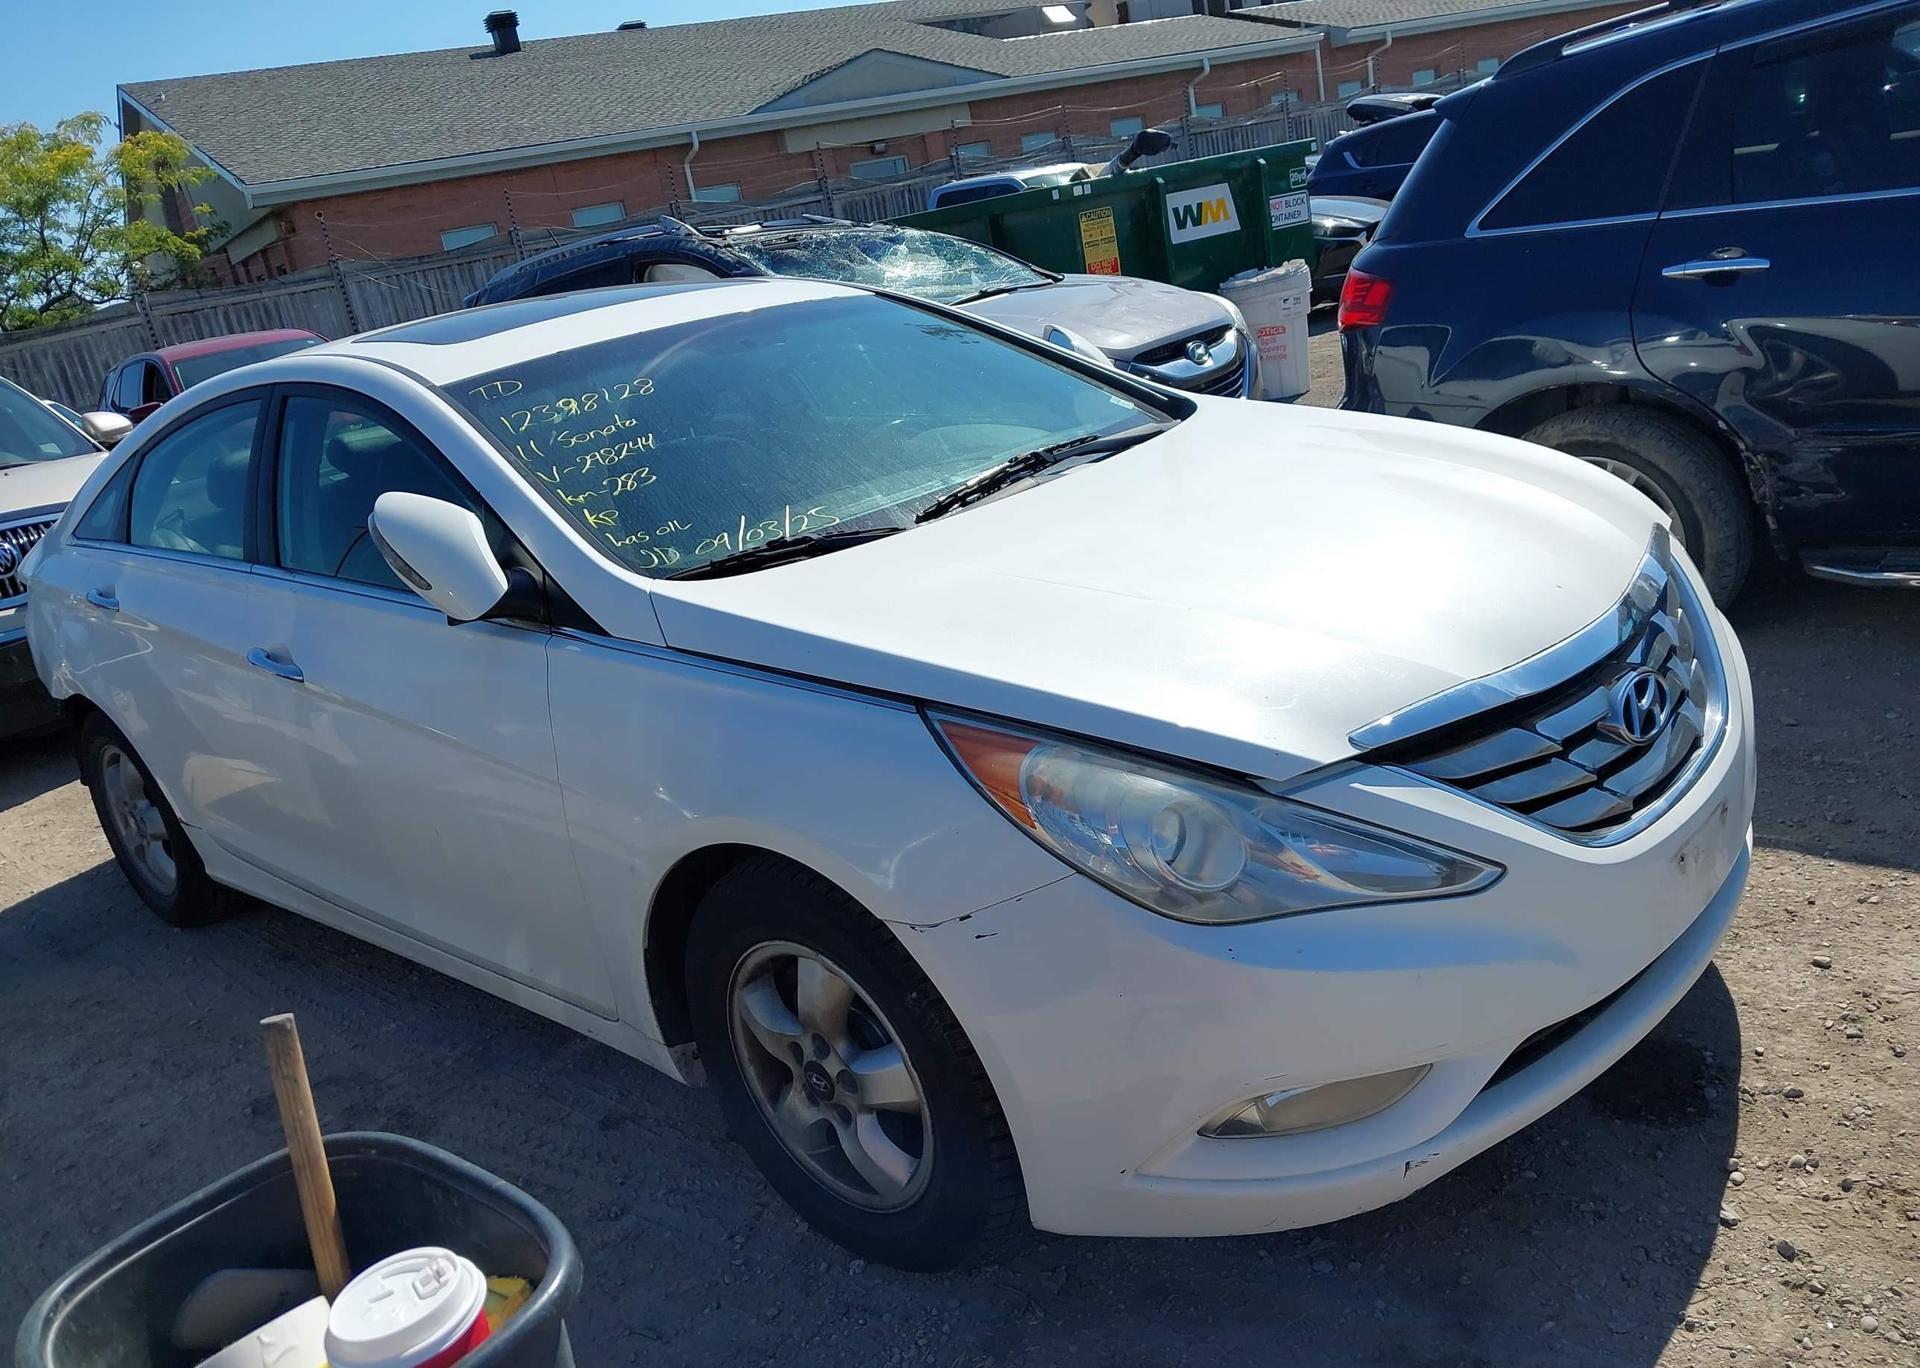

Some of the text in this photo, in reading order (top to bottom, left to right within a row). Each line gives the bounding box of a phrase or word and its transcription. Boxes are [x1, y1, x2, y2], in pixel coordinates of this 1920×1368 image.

[1284, 197, 1306, 209] BLOCK
[1086, 208, 1111, 221] CAUTION
[1172, 197, 1231, 231] WM
[1271, 210, 1302, 223] ONTAINER
[1260, 326, 1286, 336] OTICE
[557, 413, 639, 448] Sonata
[695, 504, 840, 555] 09/03/25
